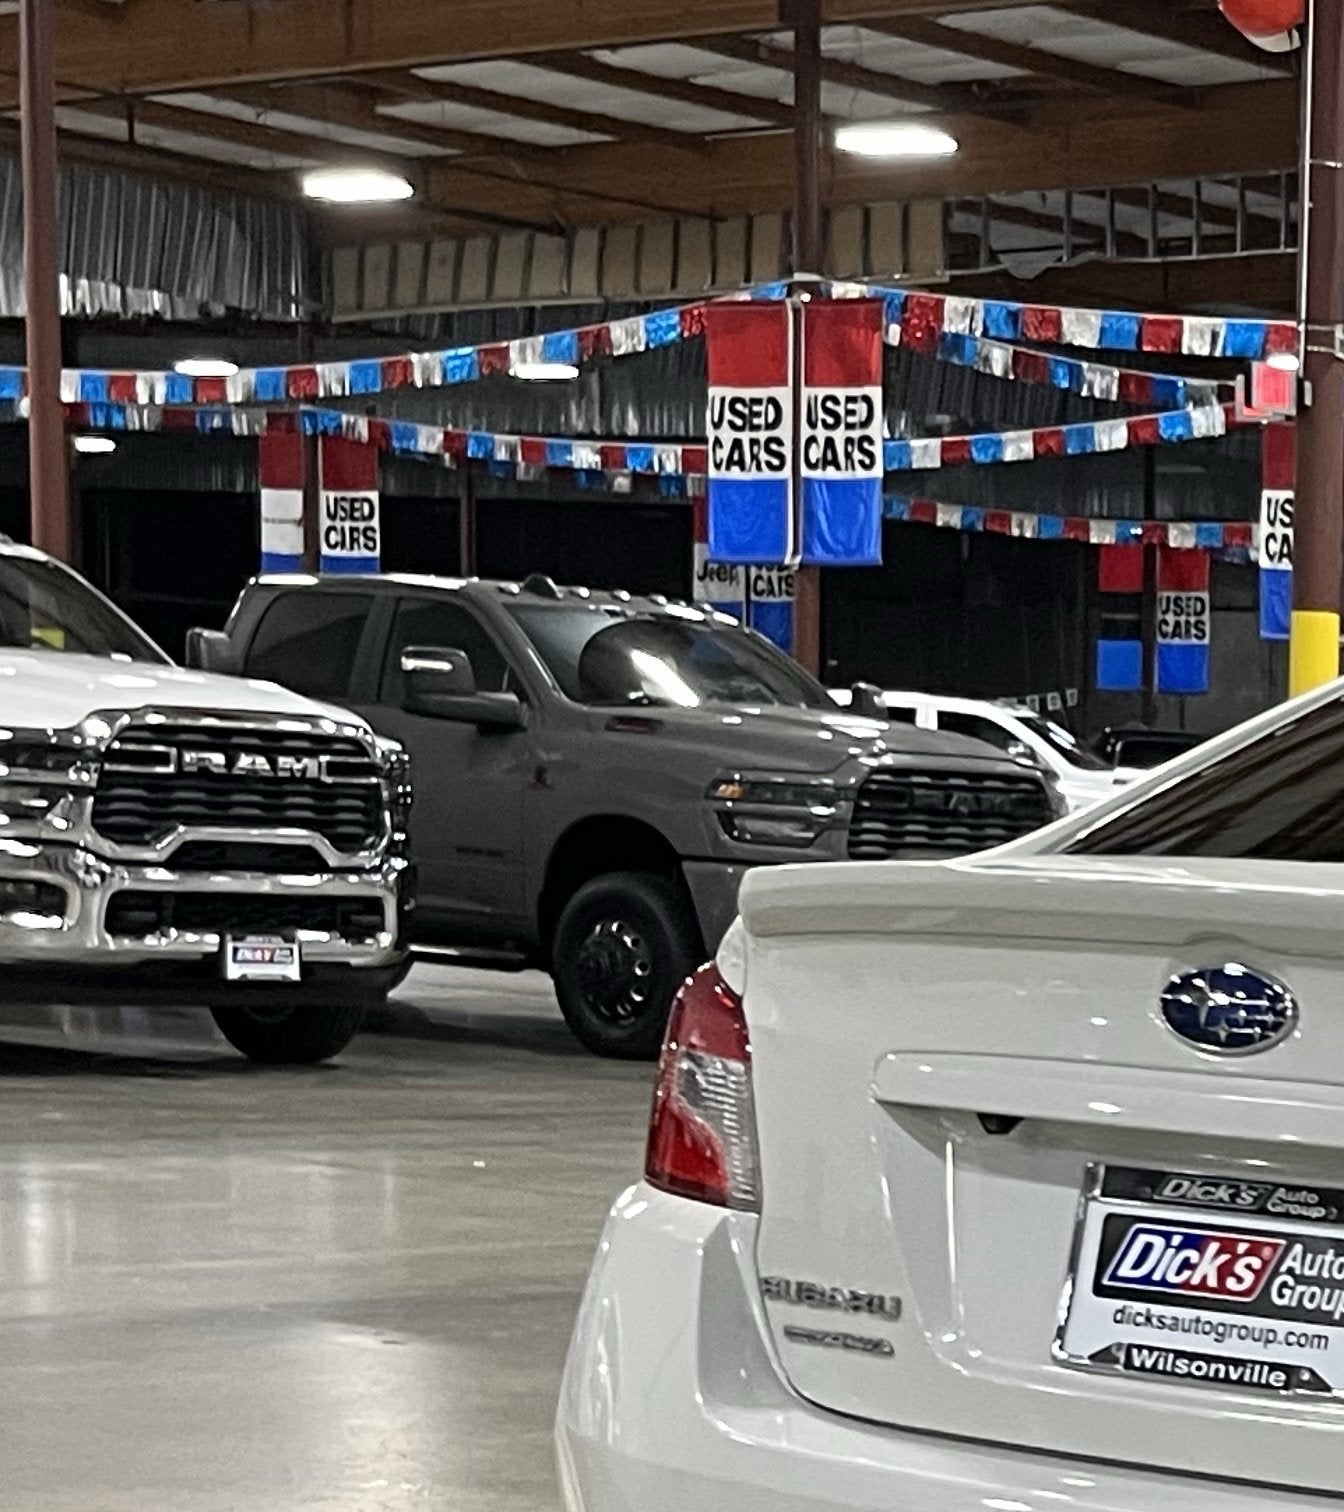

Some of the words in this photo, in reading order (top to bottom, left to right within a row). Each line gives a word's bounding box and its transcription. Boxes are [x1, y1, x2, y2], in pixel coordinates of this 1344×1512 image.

[711, 395, 782, 432] USED
[806, 394, 874, 431] USED
[712, 435, 786, 472] CARS
[804, 435, 876, 471] CARS
[326, 495, 375, 522] USED
[1266, 497, 1294, 528] US
[1265, 533, 1292, 564] CA
[1159, 595, 1206, 617] USED
[181, 751, 319, 778] RAM
[1162, 1178, 1259, 1207] Dick's
[1273, 1187, 1319, 1204] Auto
[1266, 1200, 1326, 1219] Group
[1116, 1233, 1264, 1293] Dick's
[760, 1276, 902, 1323] SUBARU
[1112, 1304, 1329, 1351] dicksautogroup.com
[1130, 1347, 1289, 1388] Wilsonville
